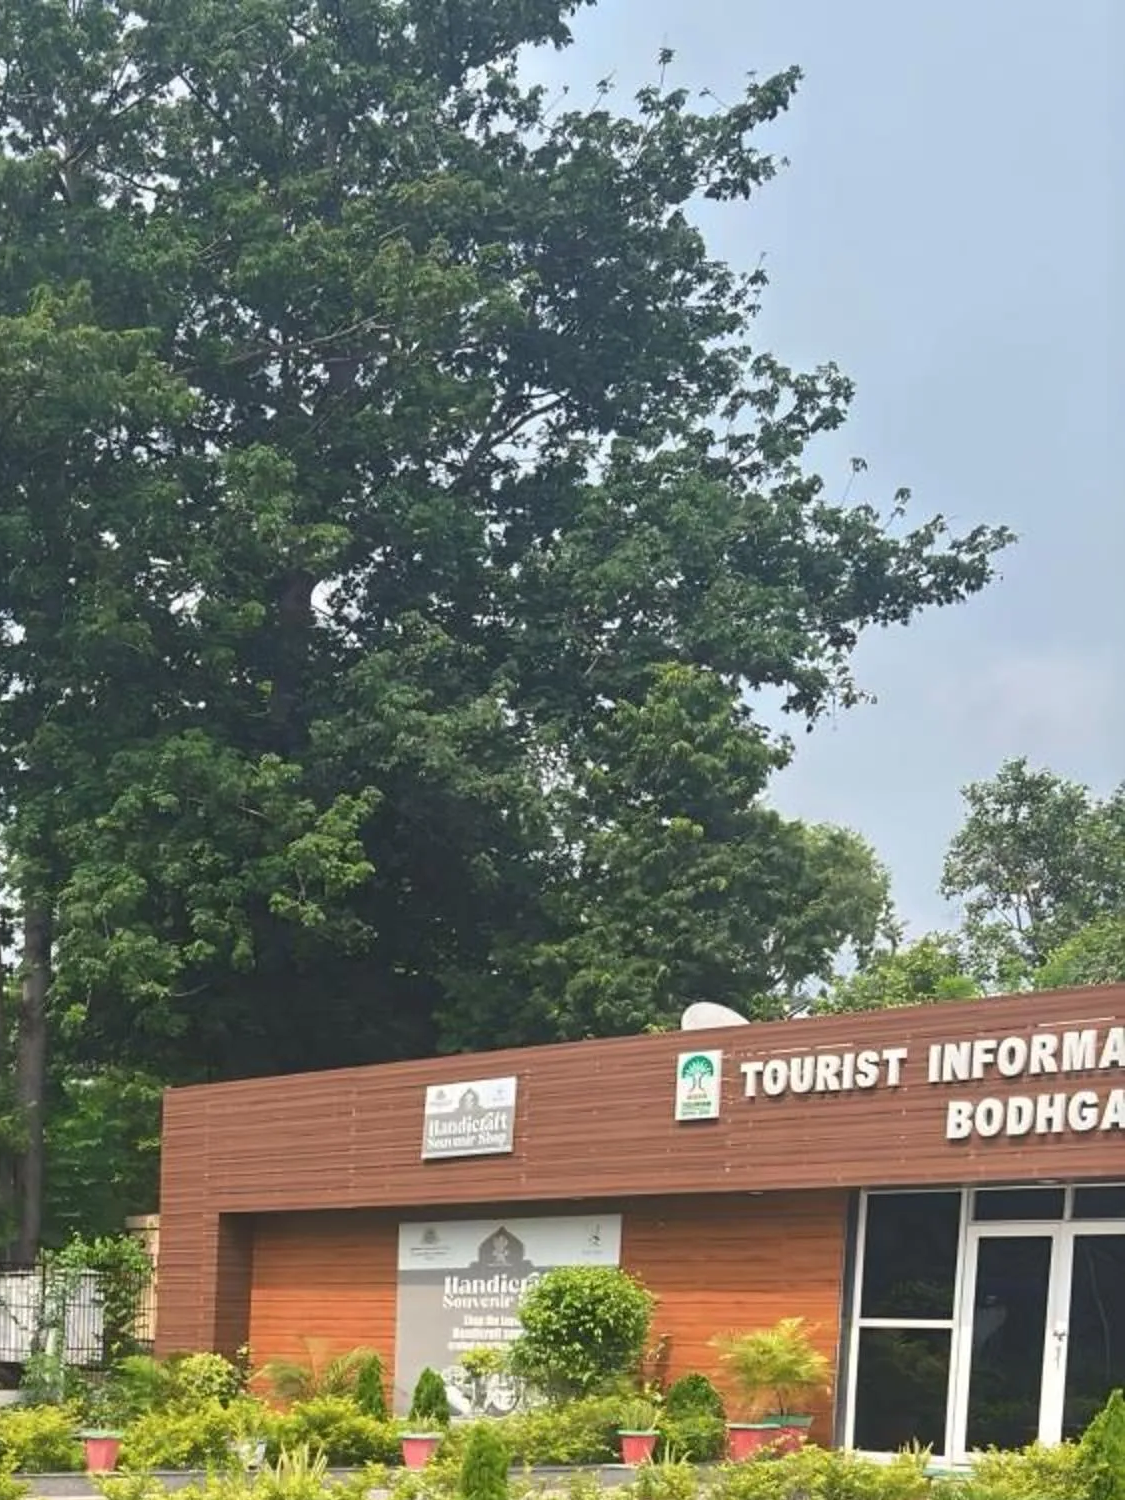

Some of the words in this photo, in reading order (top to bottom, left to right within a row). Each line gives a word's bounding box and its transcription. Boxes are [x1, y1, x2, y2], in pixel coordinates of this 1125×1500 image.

[740, 1048, 908, 1097] TOURIST
[928, 1027, 1125, 1083] INFORMA
[946, 1089, 1125, 1139] BODHGA
[444, 1272, 542, 1295] Handicr
